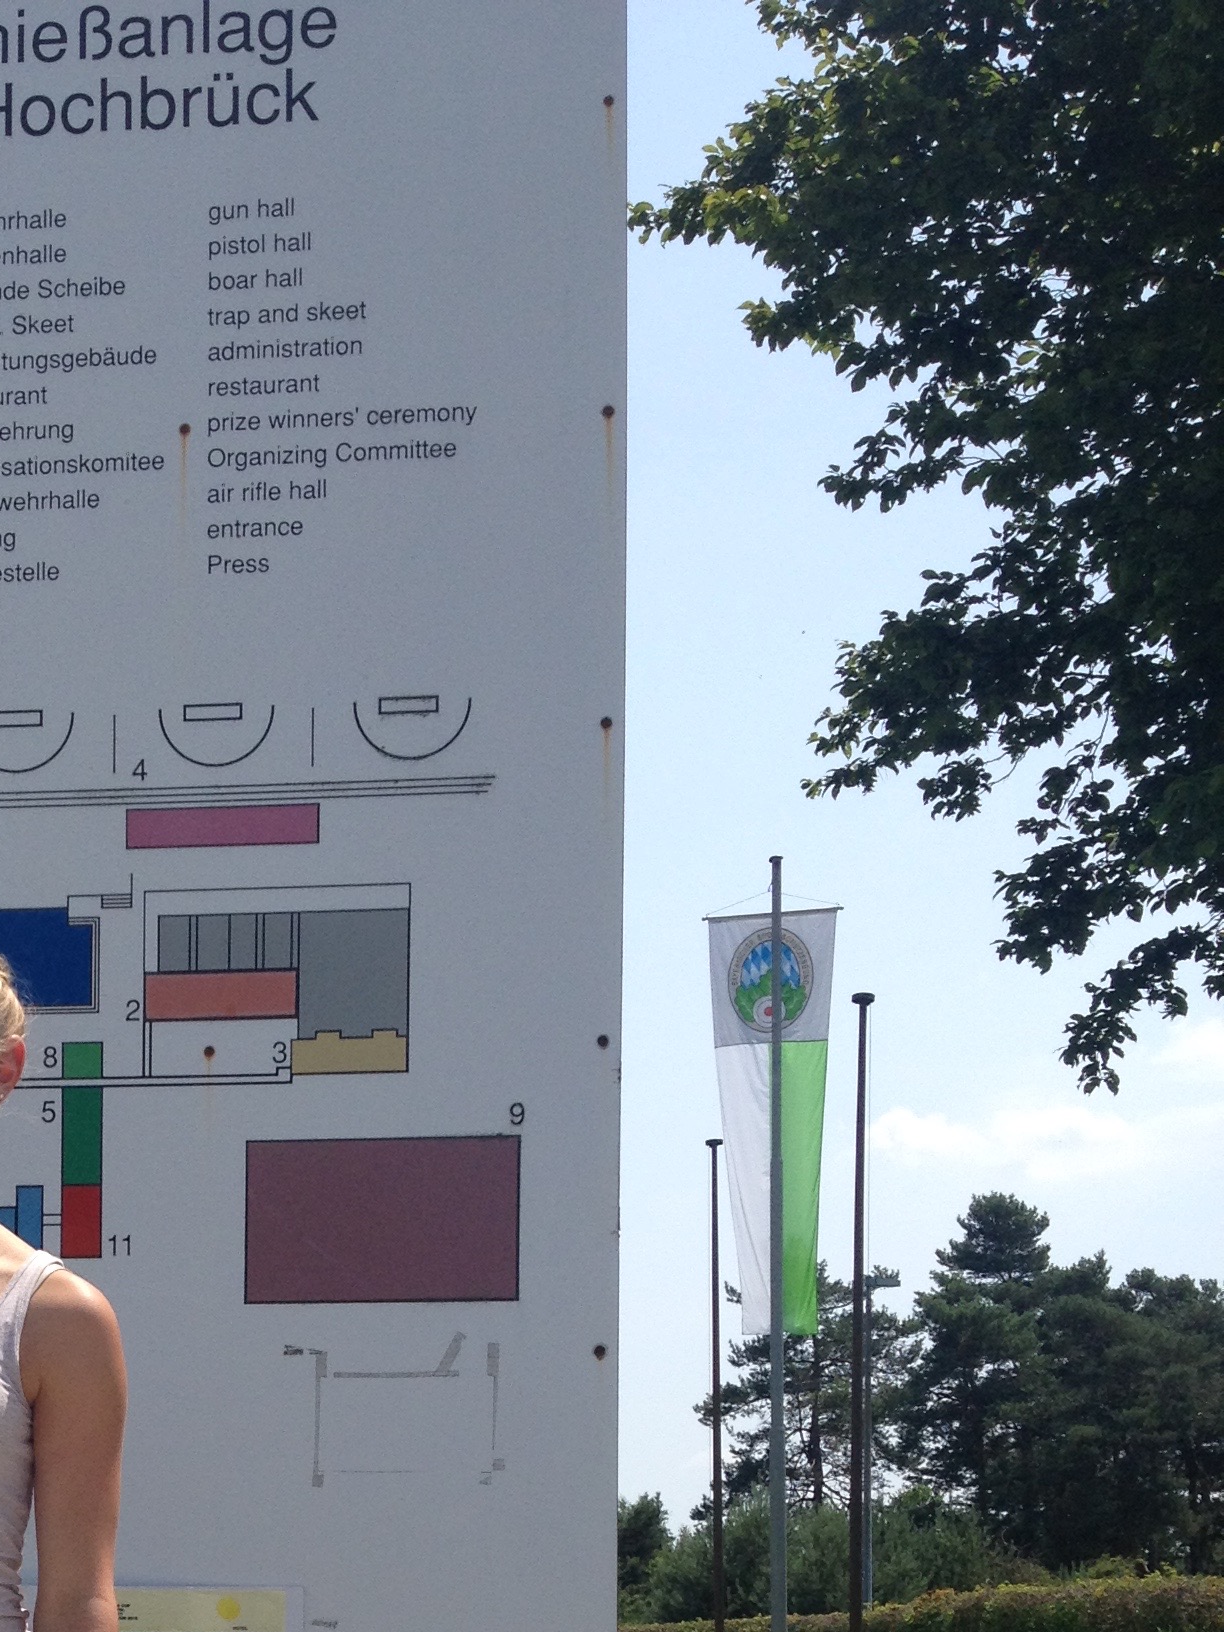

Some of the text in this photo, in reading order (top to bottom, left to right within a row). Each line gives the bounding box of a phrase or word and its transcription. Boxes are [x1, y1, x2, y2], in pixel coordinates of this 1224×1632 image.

[209, 198, 294, 225] gun hall
[209, 232, 311, 260] pistol hall
[38, 276, 125, 299] Scheibe
[209, 268, 302, 291] boar hall
[12, 315, 74, 335] Skeet
[207, 301, 366, 330] trap and skeet
[208, 337, 362, 361] administration
[209, 374, 319, 396] restaurant
[208, 406, 477, 437] prize winners' ceremony
[208, 440, 456, 471] Organizing Committee
[208, 479, 326, 503] air rifle hall
[207, 520, 303, 539] entrance
[208, 555, 269, 574] Press
[132, 758, 148, 781] 4
[125, 999, 141, 1022] 2
[43, 1046, 58, 1068] 8
[272, 1041, 287, 1063] 3
[41, 1101, 56, 1123] 5
[509, 1102, 525, 1125] 9
[108, 1234, 132, 1257] 11
